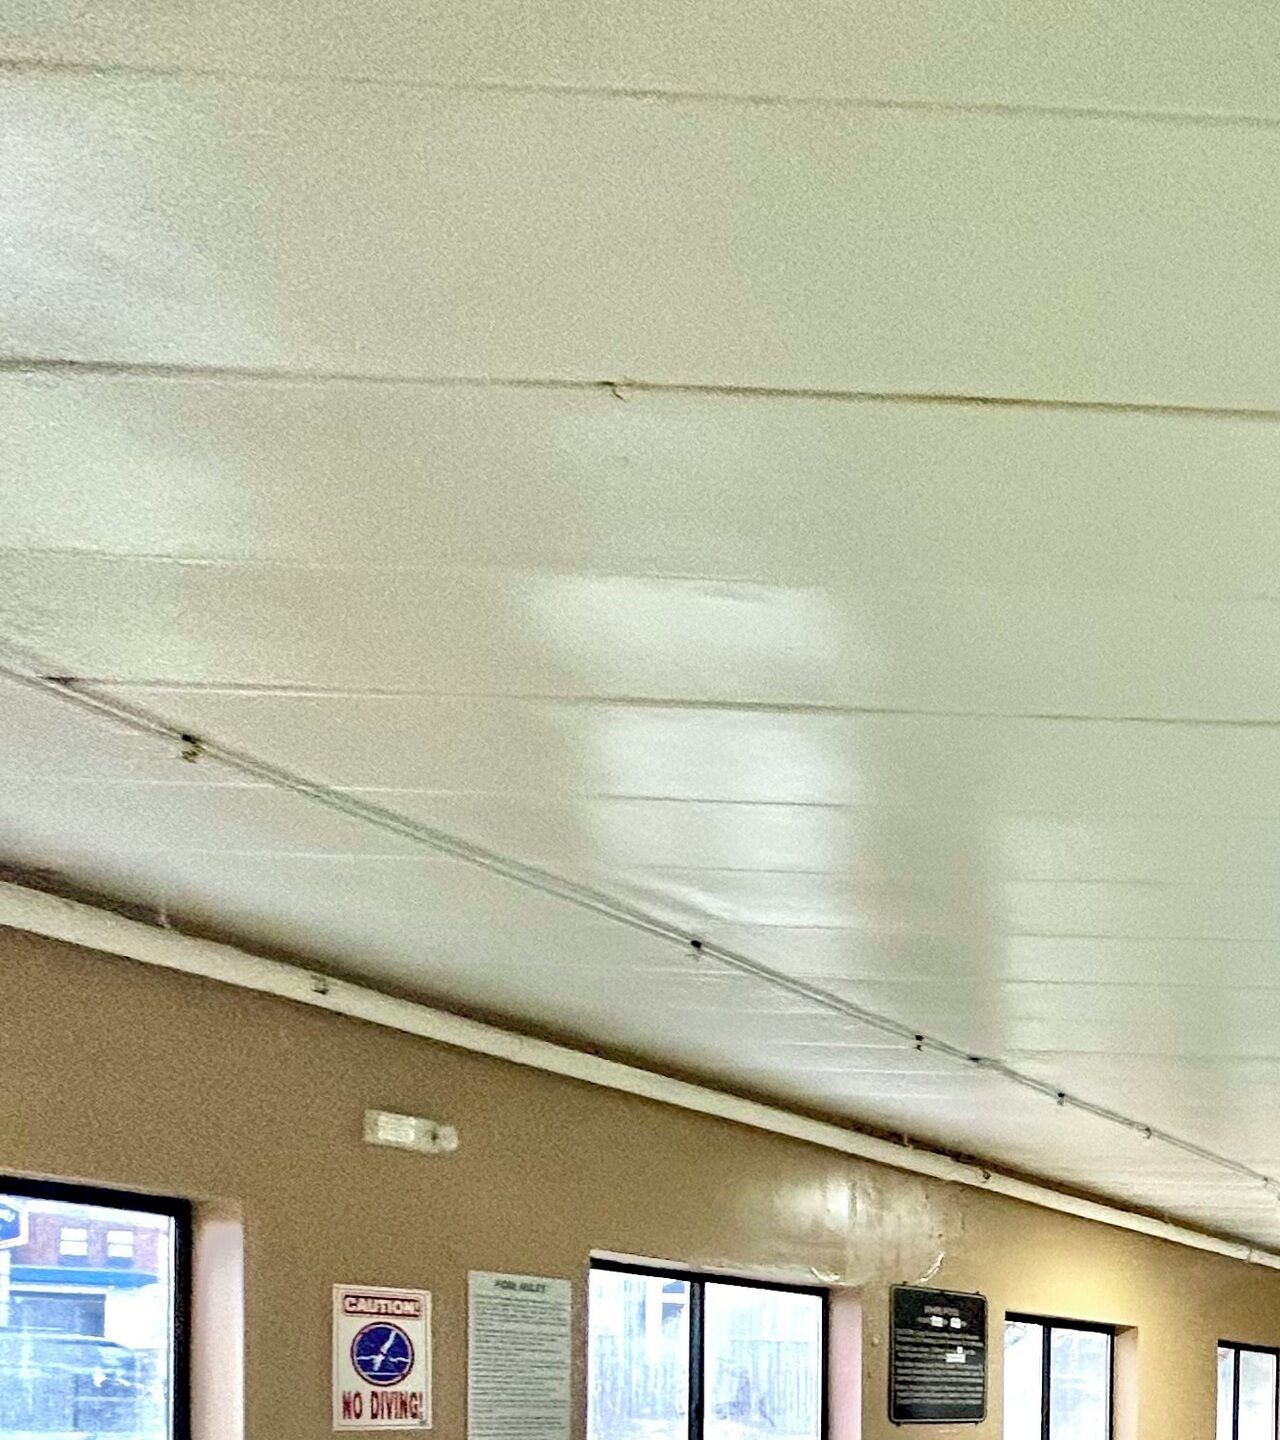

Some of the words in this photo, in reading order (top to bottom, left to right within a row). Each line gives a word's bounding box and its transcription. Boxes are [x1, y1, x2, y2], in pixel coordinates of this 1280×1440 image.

[344, 1298, 421, 1317] CAUTION!
[342, 1391, 363, 1420] NO
[370, 1391, 424, 1420] DIVING!
